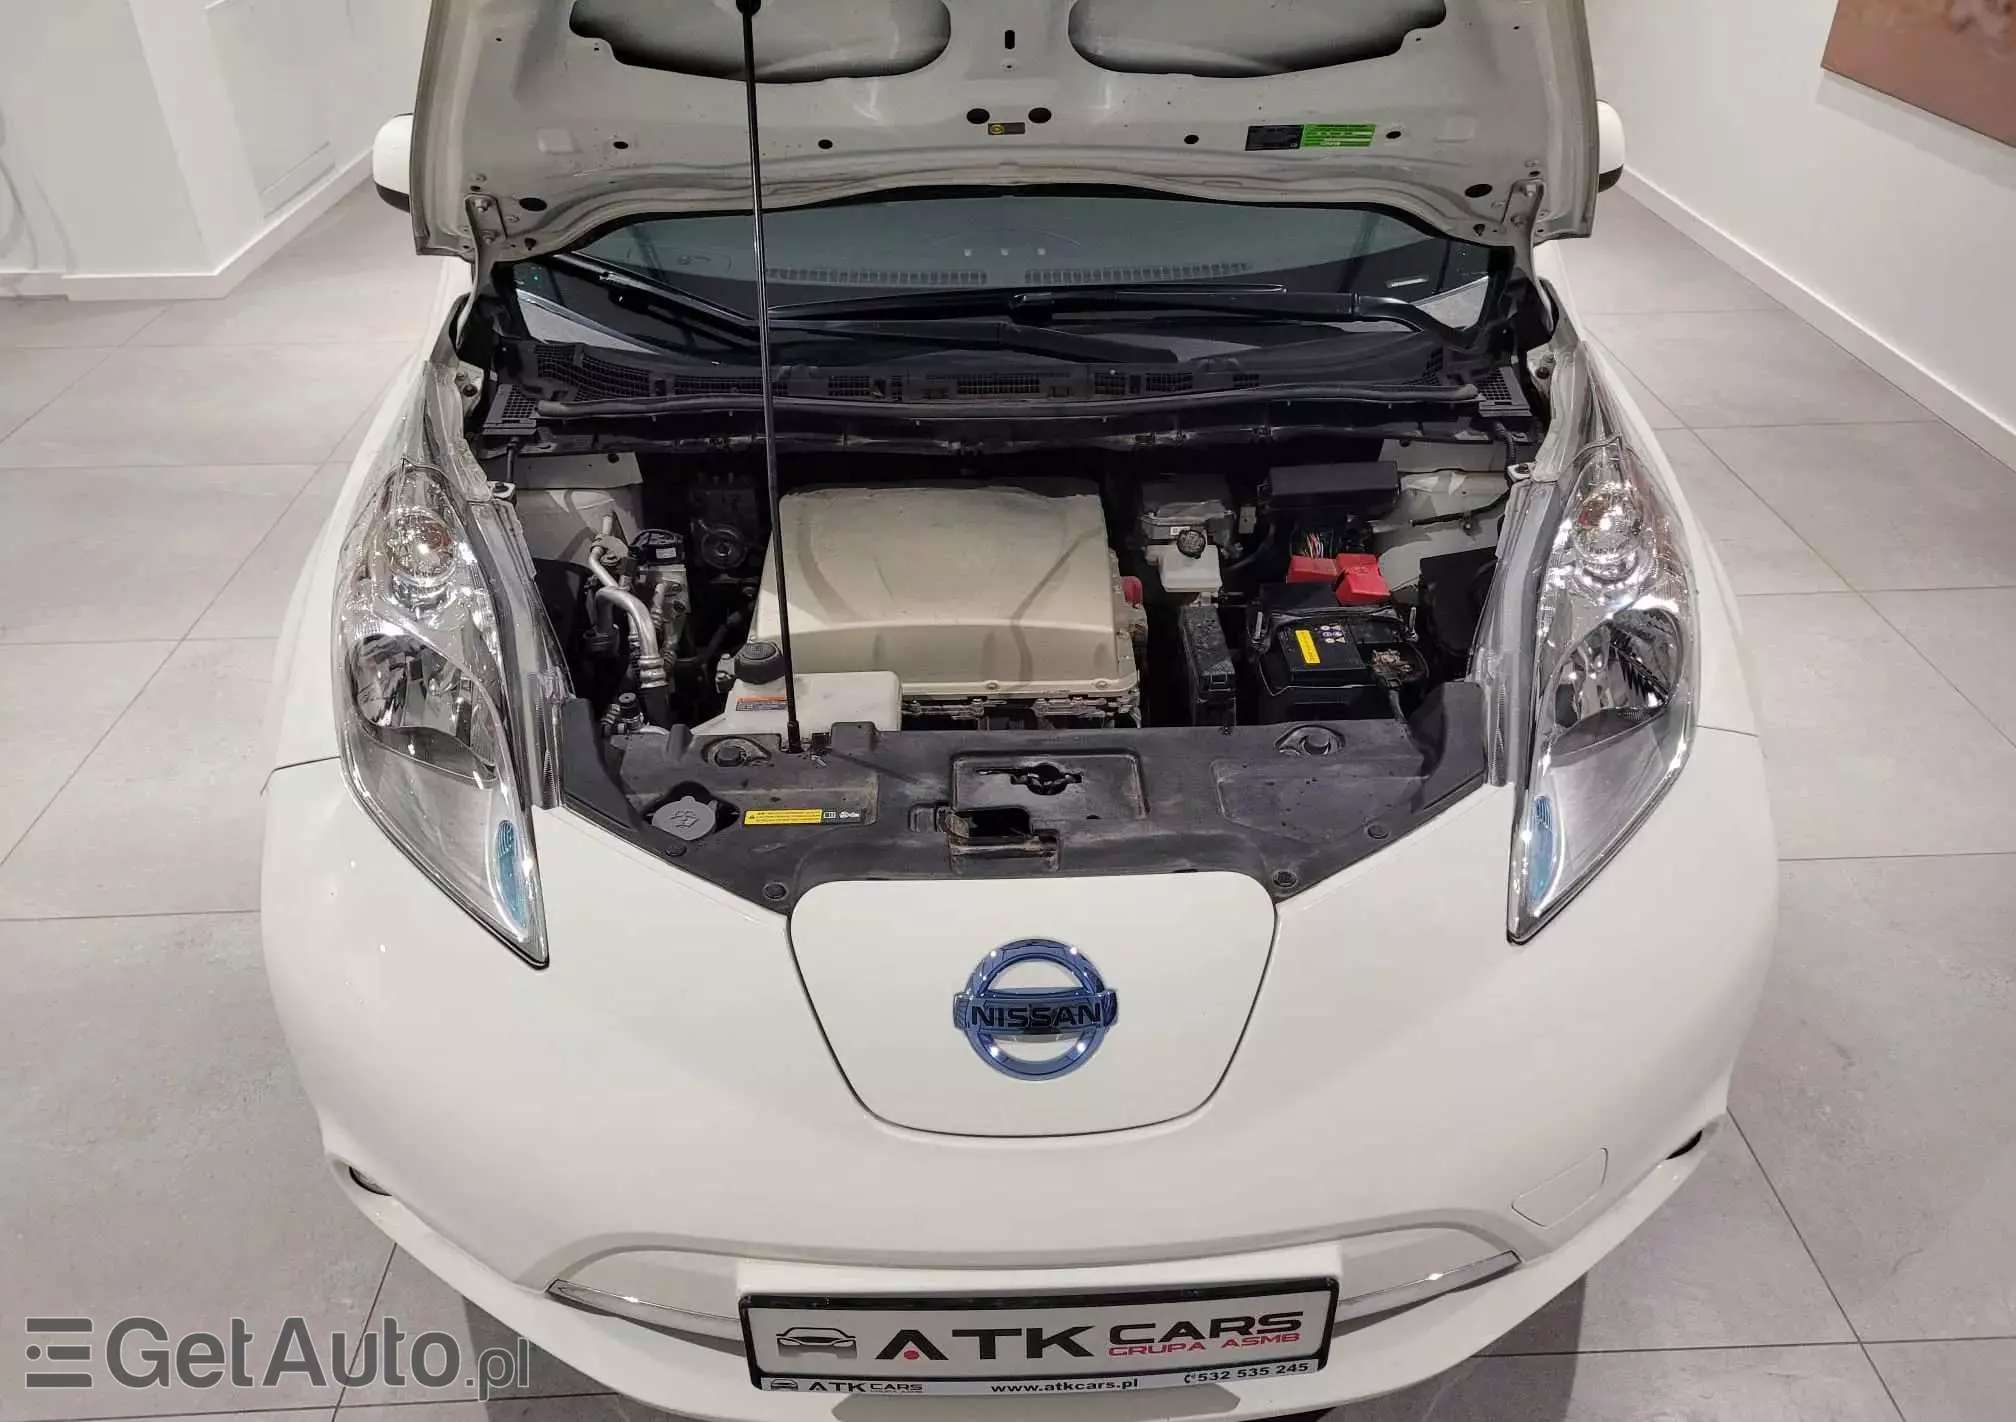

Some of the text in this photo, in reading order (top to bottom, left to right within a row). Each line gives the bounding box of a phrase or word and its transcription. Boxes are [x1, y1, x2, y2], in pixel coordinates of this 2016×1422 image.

[971, 1004, 1101, 1027] NISSAN
[875, 1312, 1303, 1361] ATK CARS
[1108, 1332, 1301, 1356] GRUPA ASMB
[1197, 1363, 1308, 1381] 532 535 245
[808, 1382, 866, 1392] ATK
[870, 1383, 922, 1391] CARS
[992, 1378, 1138, 1392] www.atkcars.pl
